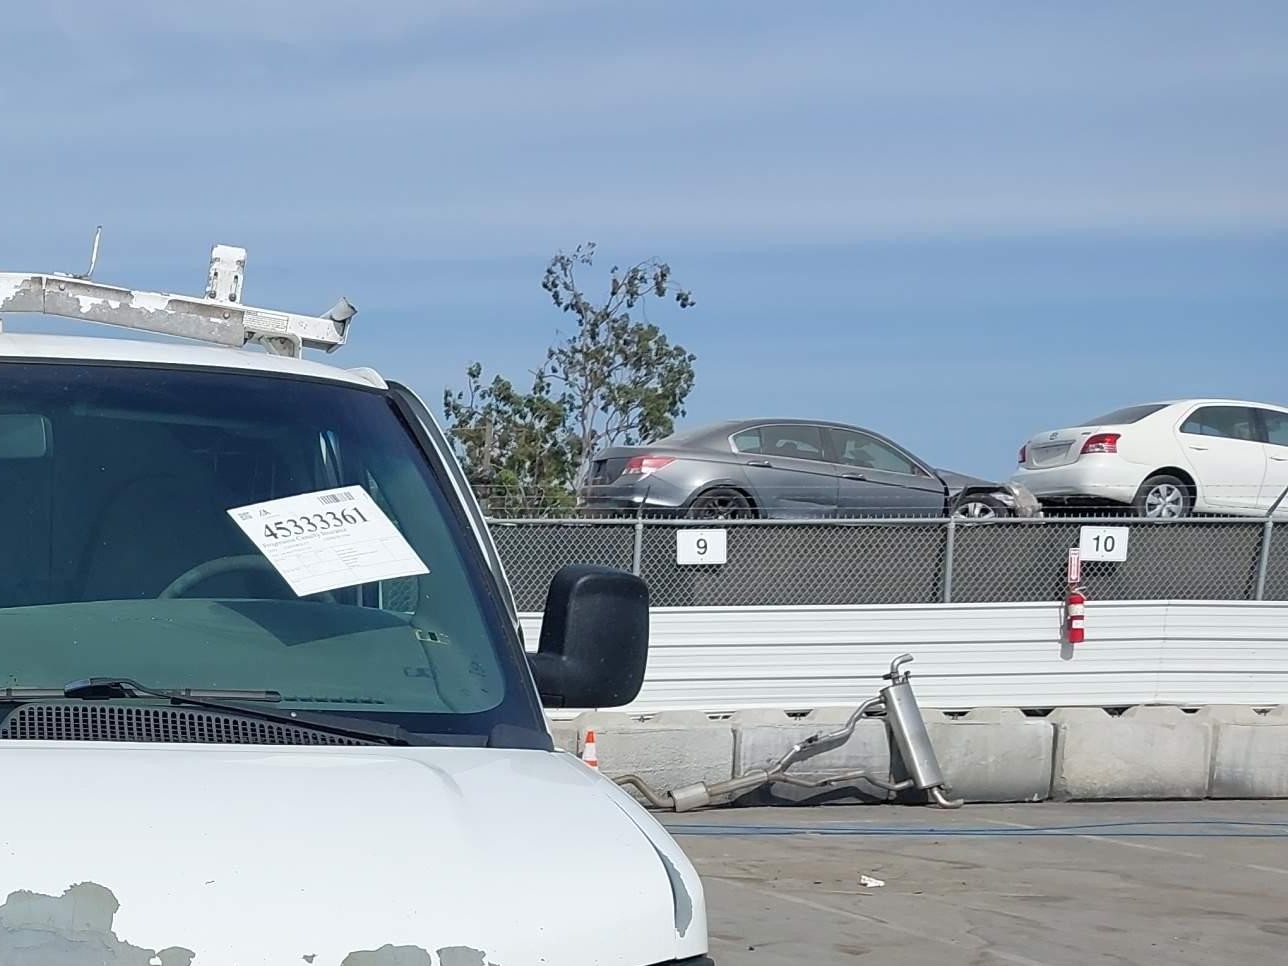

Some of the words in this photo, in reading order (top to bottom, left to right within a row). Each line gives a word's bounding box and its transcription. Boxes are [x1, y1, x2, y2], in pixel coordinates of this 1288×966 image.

[263, 506, 369, 540] 45333361
[696, 538, 707, 555] 9
[1093, 535, 1115, 552] 10
